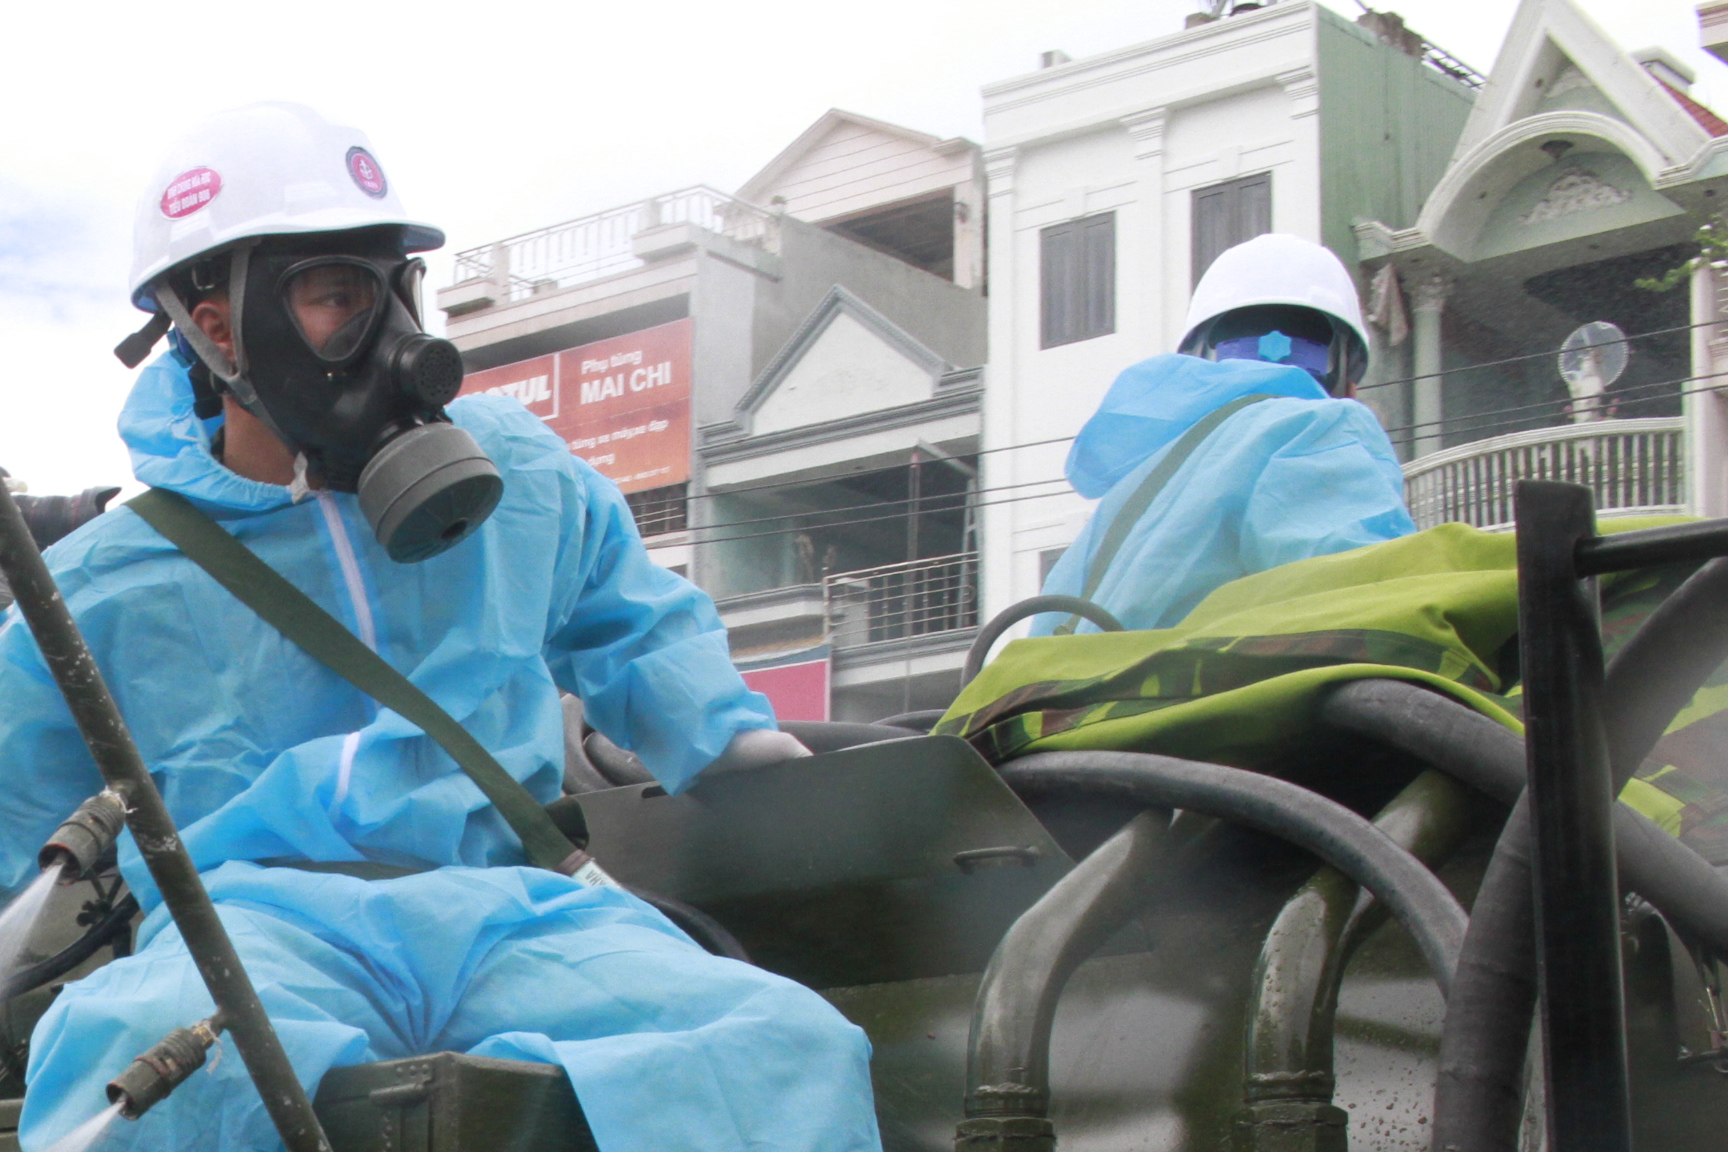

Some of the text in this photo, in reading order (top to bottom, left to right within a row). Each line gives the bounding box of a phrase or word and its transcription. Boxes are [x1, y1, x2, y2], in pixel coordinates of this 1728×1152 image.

[474, 375, 552, 405] TUL
[580, 361, 671, 405] MAI CHI
